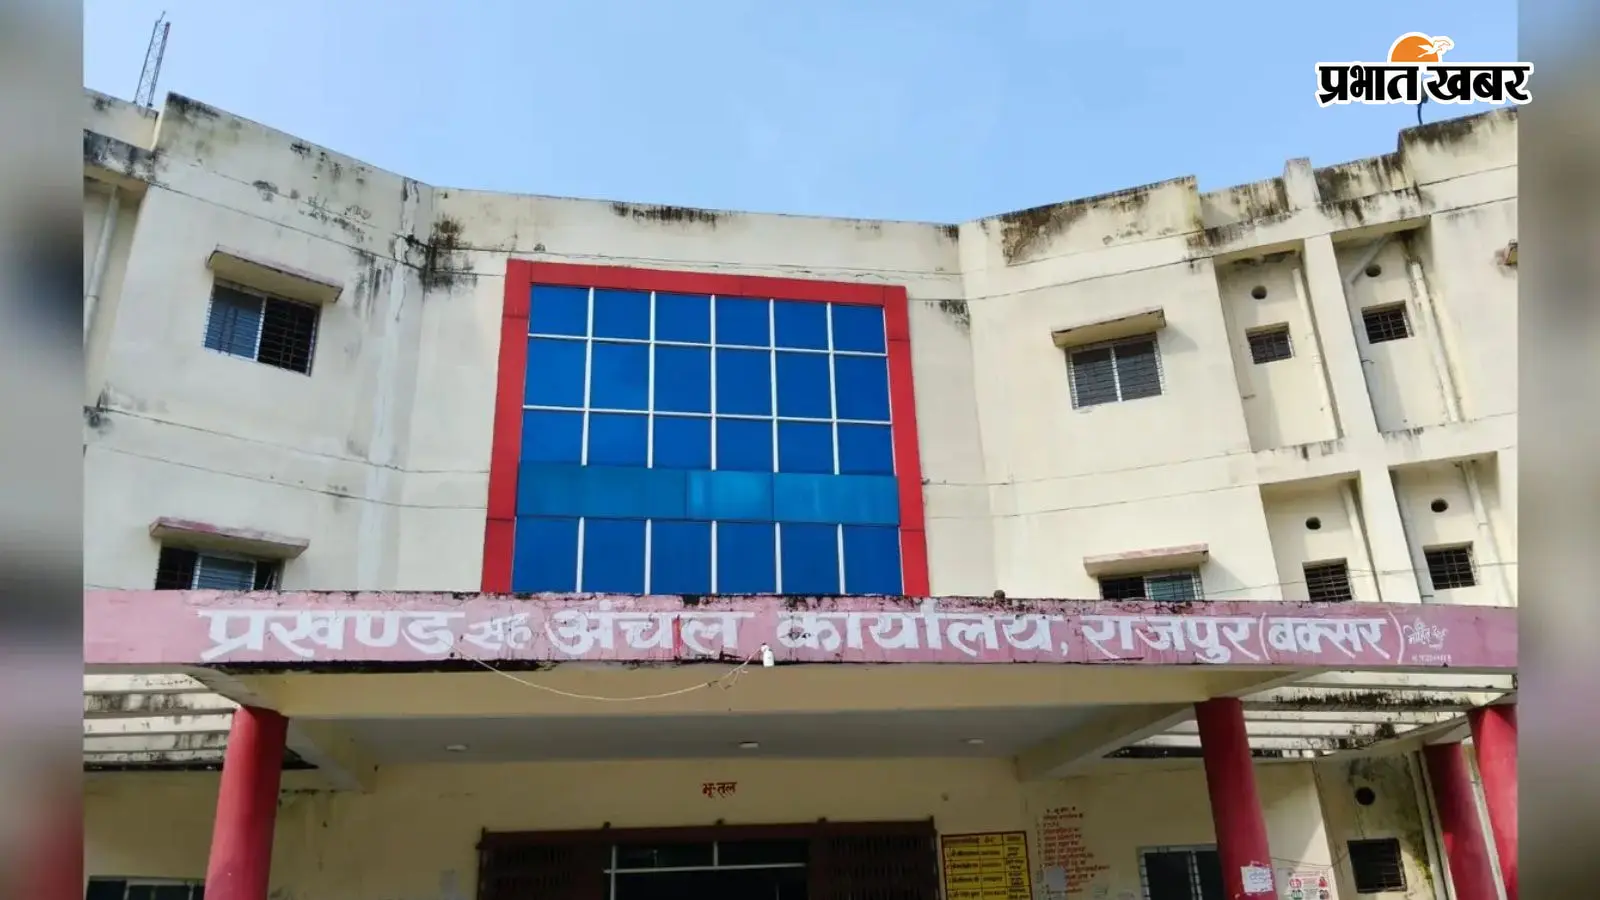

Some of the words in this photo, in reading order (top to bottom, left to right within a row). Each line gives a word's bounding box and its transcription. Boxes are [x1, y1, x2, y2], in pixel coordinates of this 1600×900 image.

[198, 608, 464, 660] प्रखण्ड
[464, 612, 532, 651] सह
[544, 601, 755, 655] अंचल
